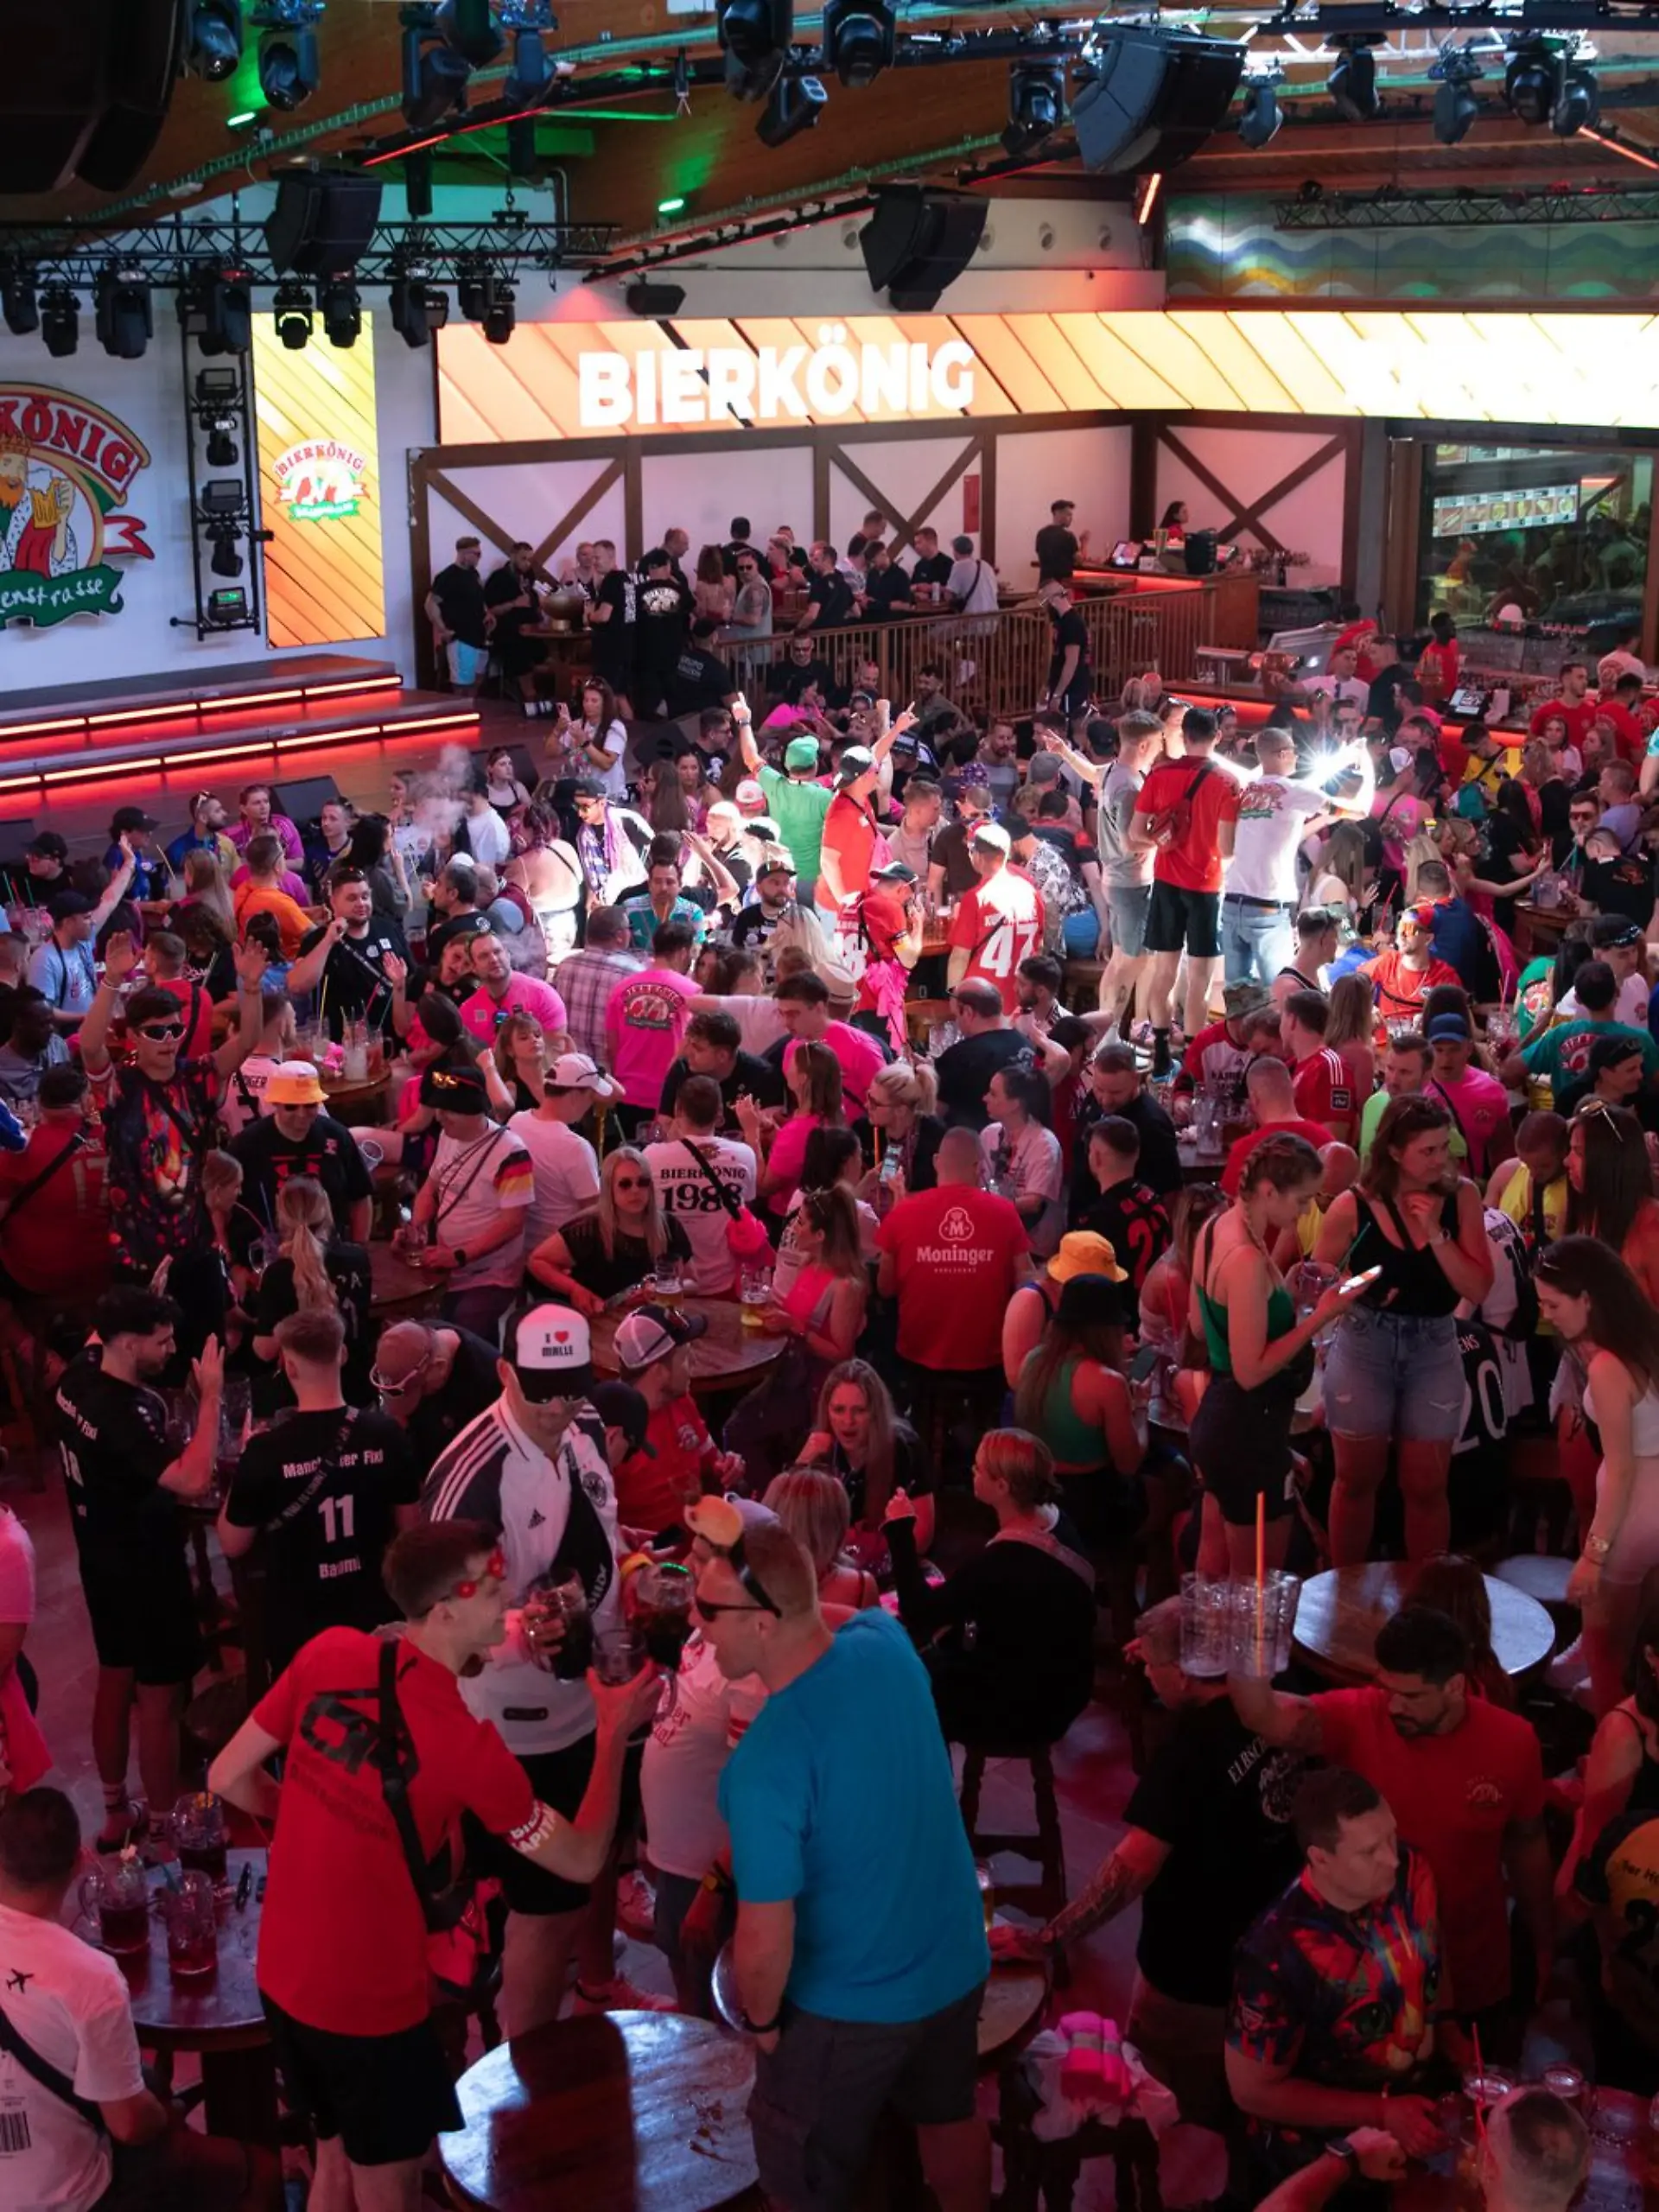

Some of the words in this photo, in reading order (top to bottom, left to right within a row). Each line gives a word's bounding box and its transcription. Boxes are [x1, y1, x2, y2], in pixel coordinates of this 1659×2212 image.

[579, 323, 975, 427] BIERKÖNIG
[980, 925, 1039, 978] 47
[917, 1244, 994, 1265] Moninger
[545, 1333, 550, 1344] I
[318, 1494, 354, 1542] 11
